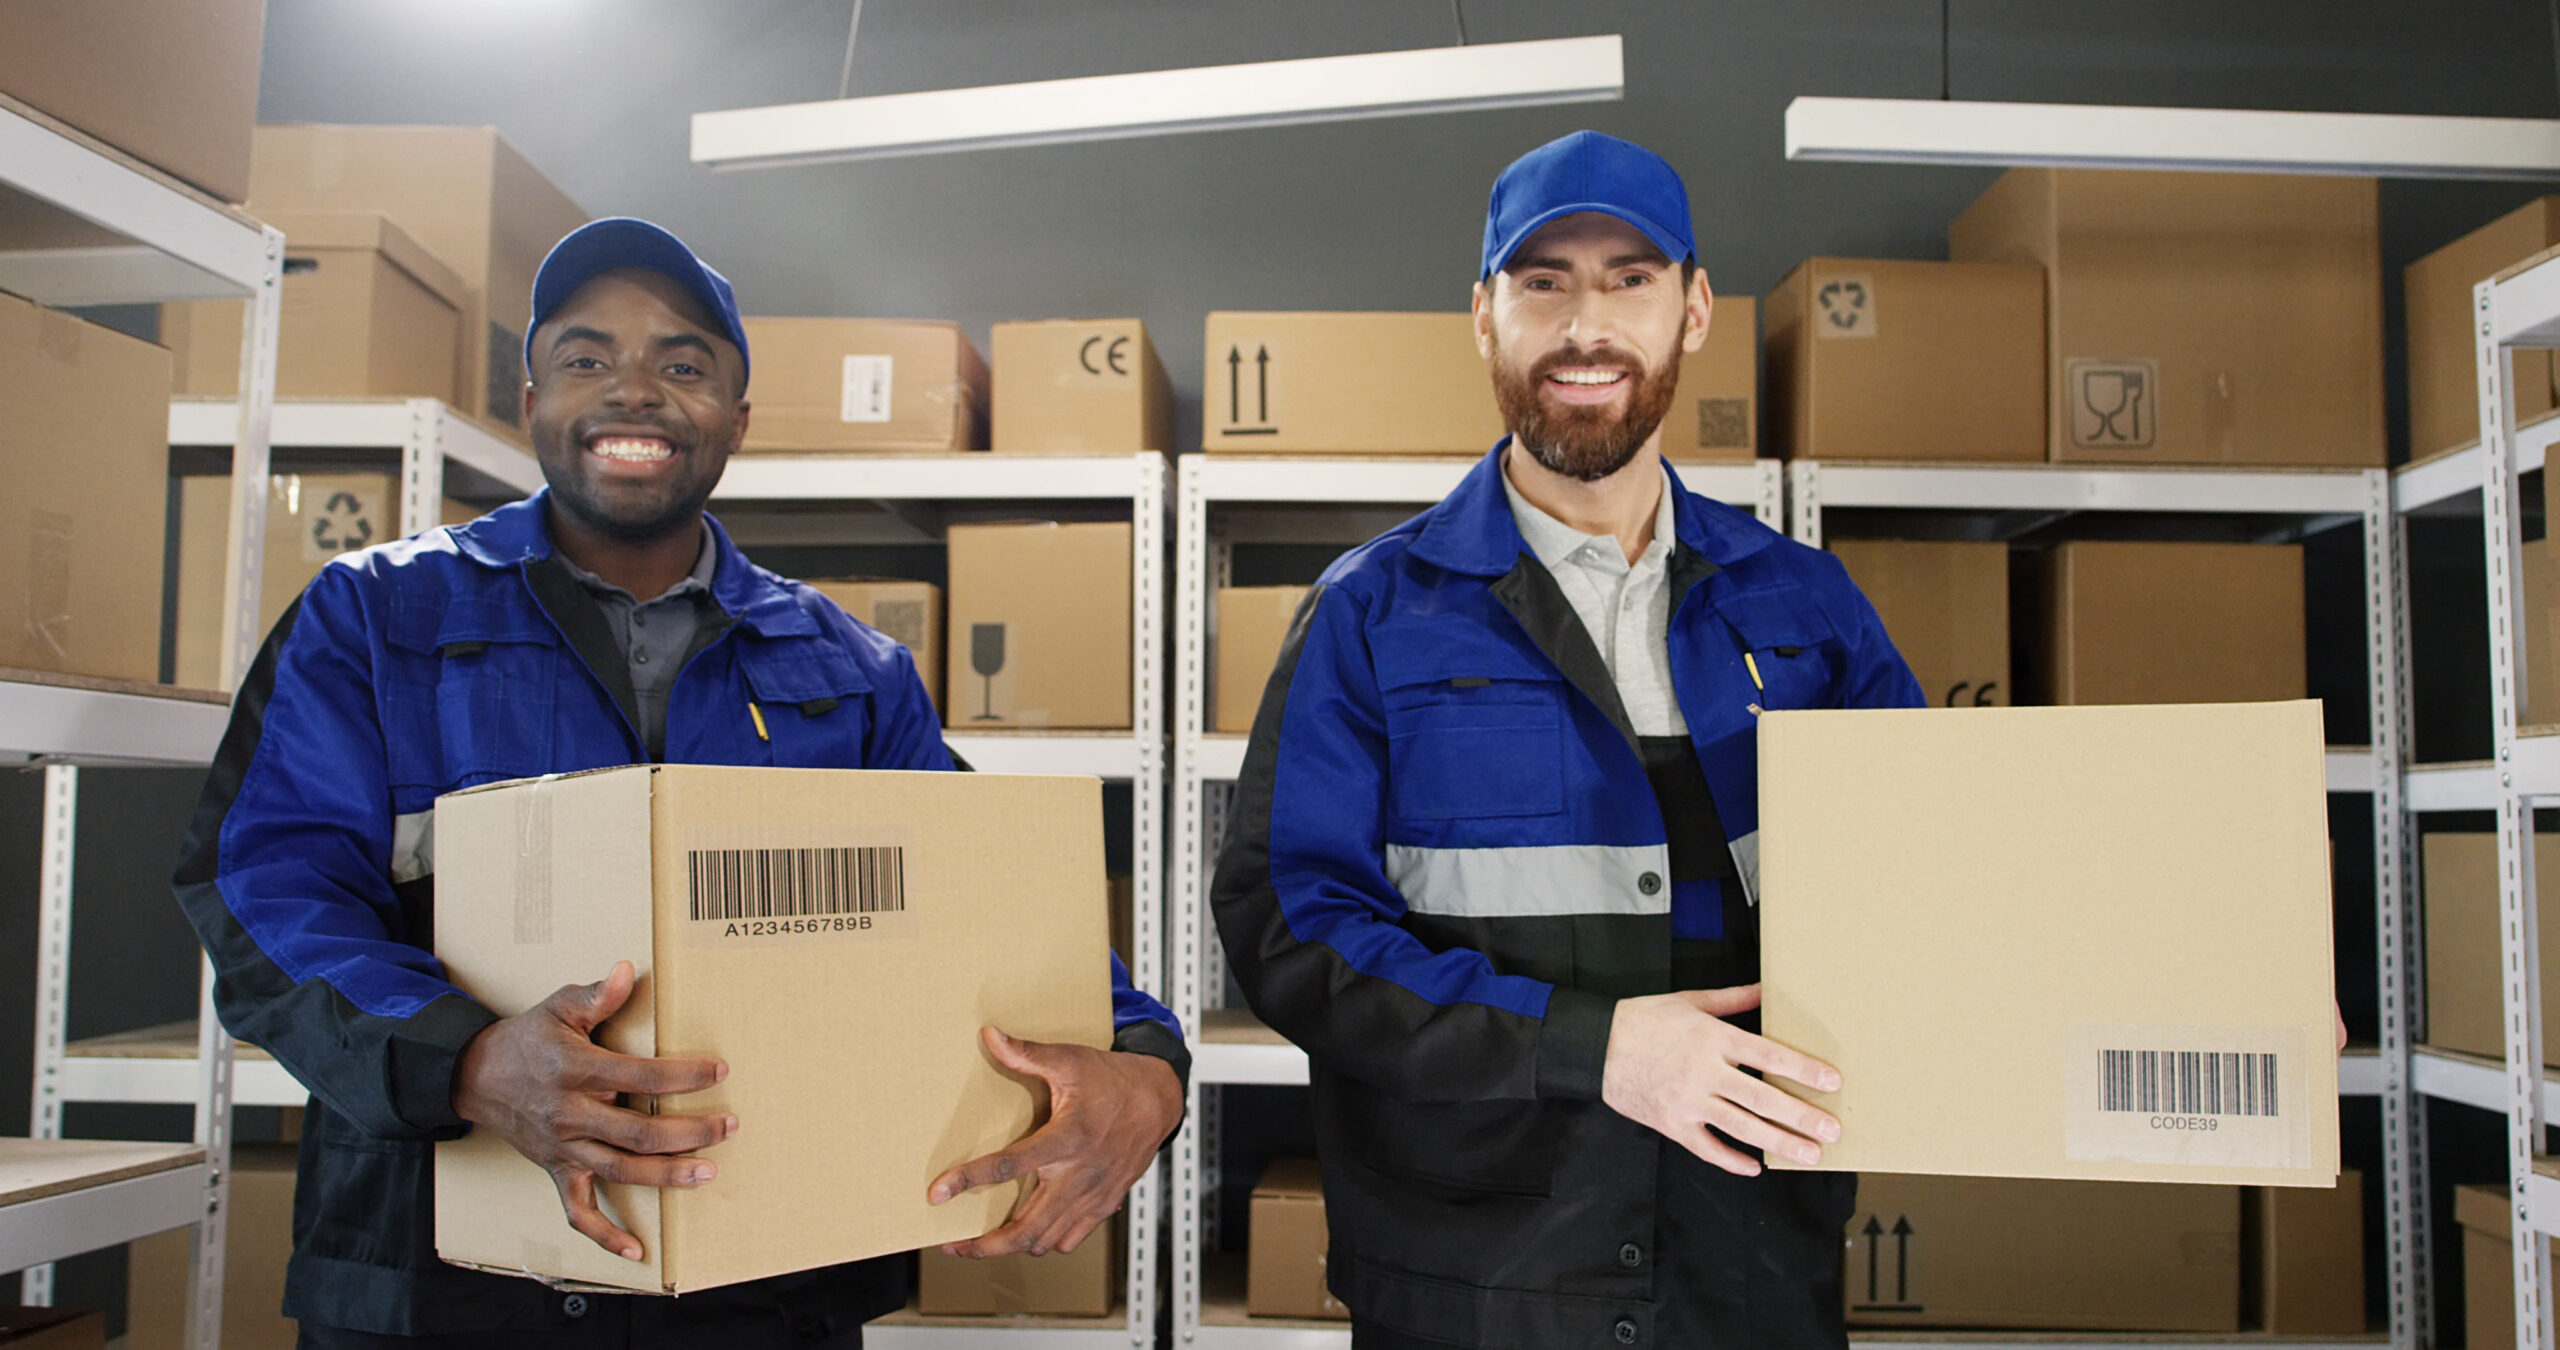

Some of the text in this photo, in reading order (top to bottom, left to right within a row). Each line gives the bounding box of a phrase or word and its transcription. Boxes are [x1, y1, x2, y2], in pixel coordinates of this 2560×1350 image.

[1080, 336, 1128, 375] CE
[725, 916, 873, 937] A123456789B
[2150, 1116, 2218, 1131] CODE39
